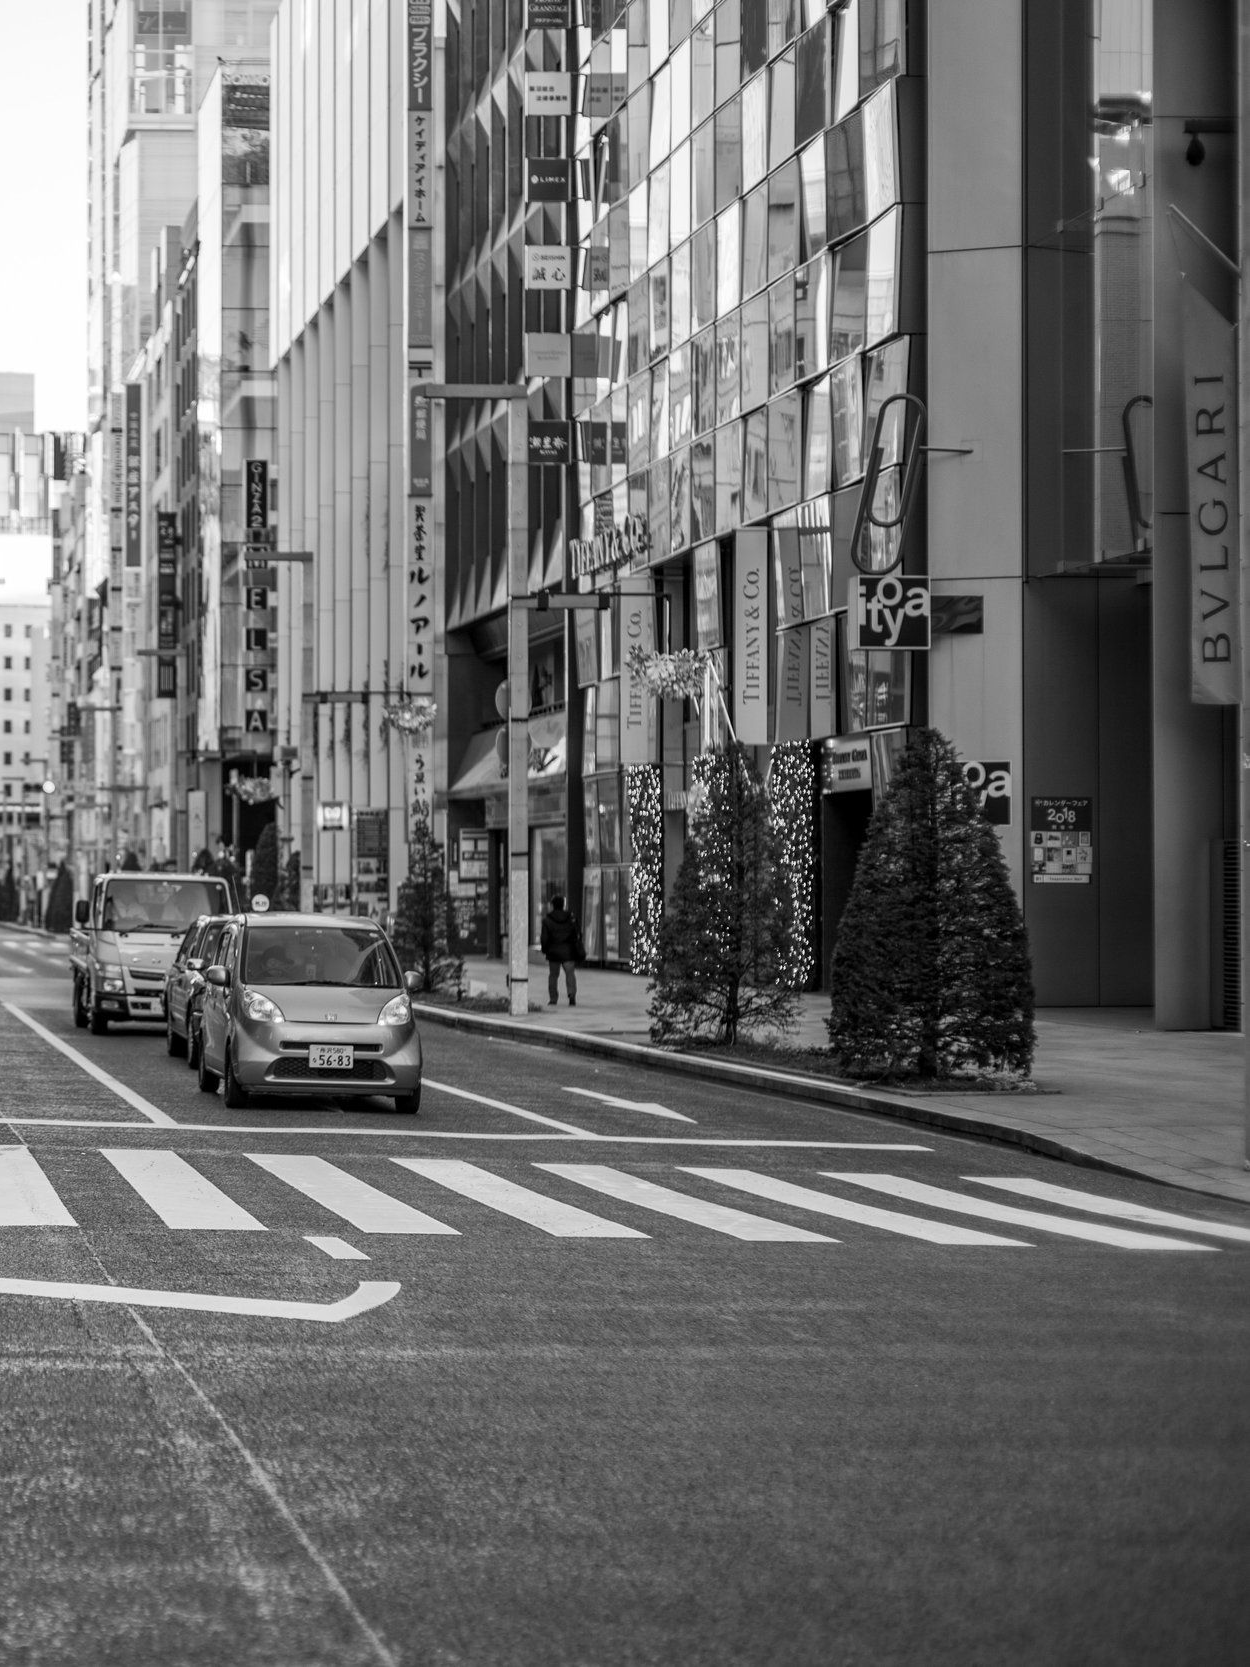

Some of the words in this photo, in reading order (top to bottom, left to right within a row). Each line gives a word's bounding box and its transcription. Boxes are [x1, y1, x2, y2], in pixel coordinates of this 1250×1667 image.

[1194, 375, 1232, 665] BVLGARI
[858, 575, 929, 646] itoya
[742, 622, 760, 705] TIFFANY
[1047, 806, 1076, 823] 2018
[318, 1055, 351, 1067] 56-83
